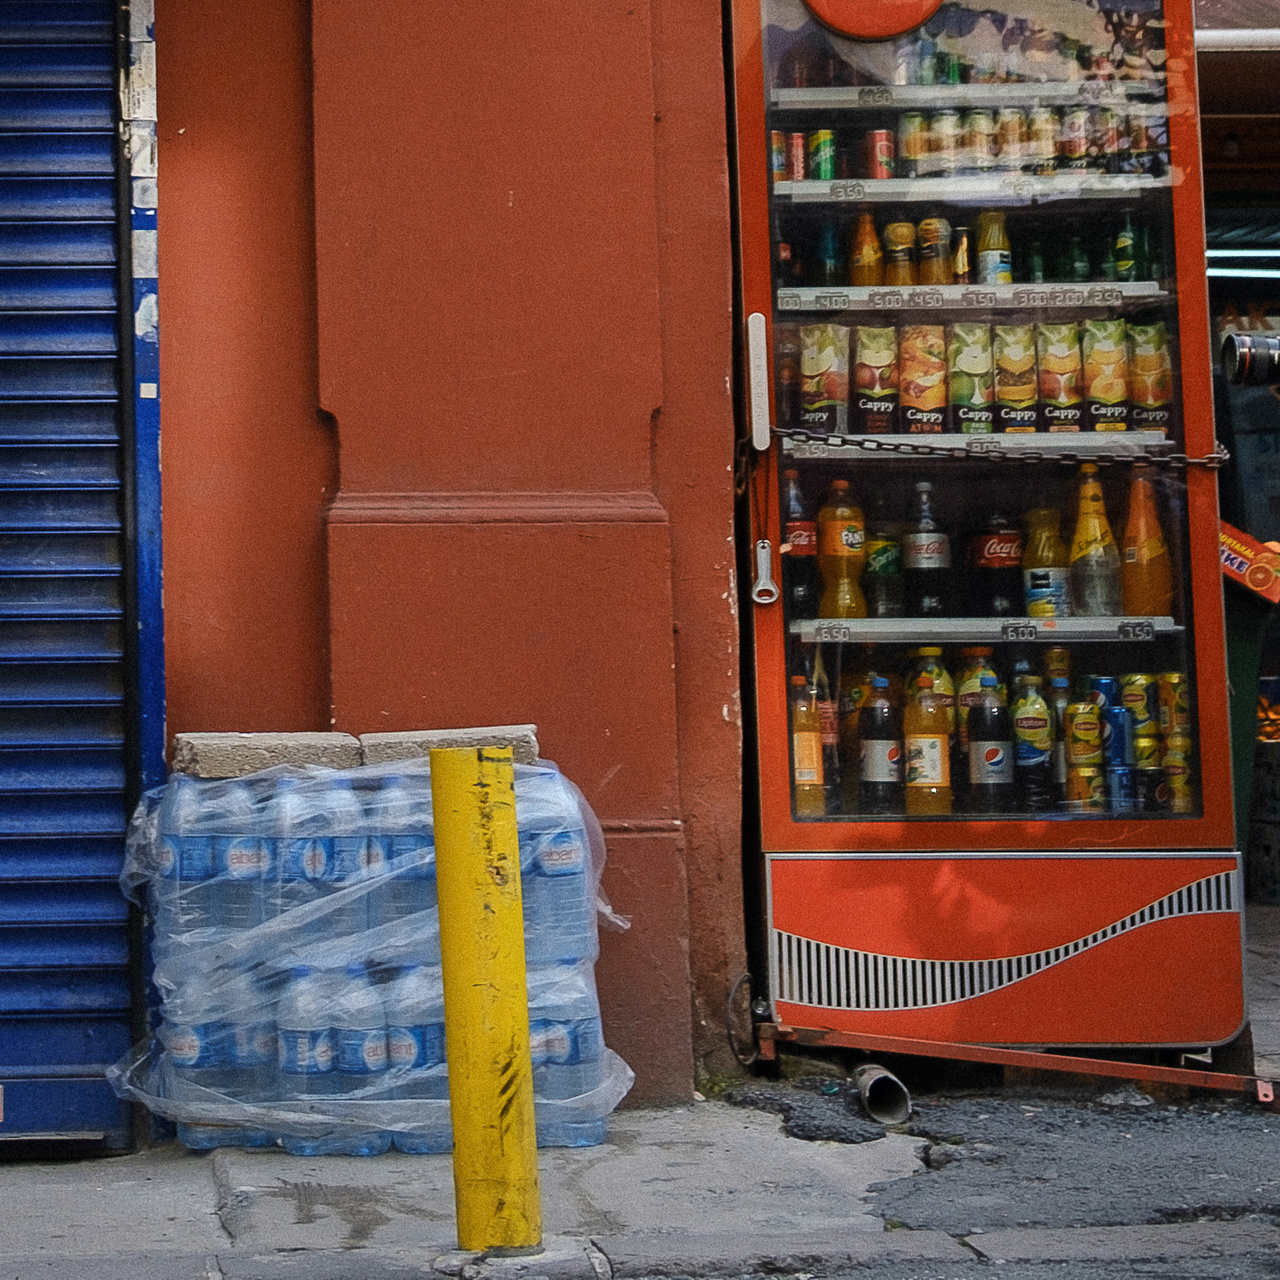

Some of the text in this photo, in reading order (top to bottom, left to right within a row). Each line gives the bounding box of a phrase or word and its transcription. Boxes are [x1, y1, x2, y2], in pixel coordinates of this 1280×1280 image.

[858, 398, 895, 412] Cappy
[1090, 404, 1128, 418] Cappy
[906, 409, 944, 423] Cappy
[1000, 408, 1038, 421] Cappy
[1044, 406, 1081, 420] Cappy
